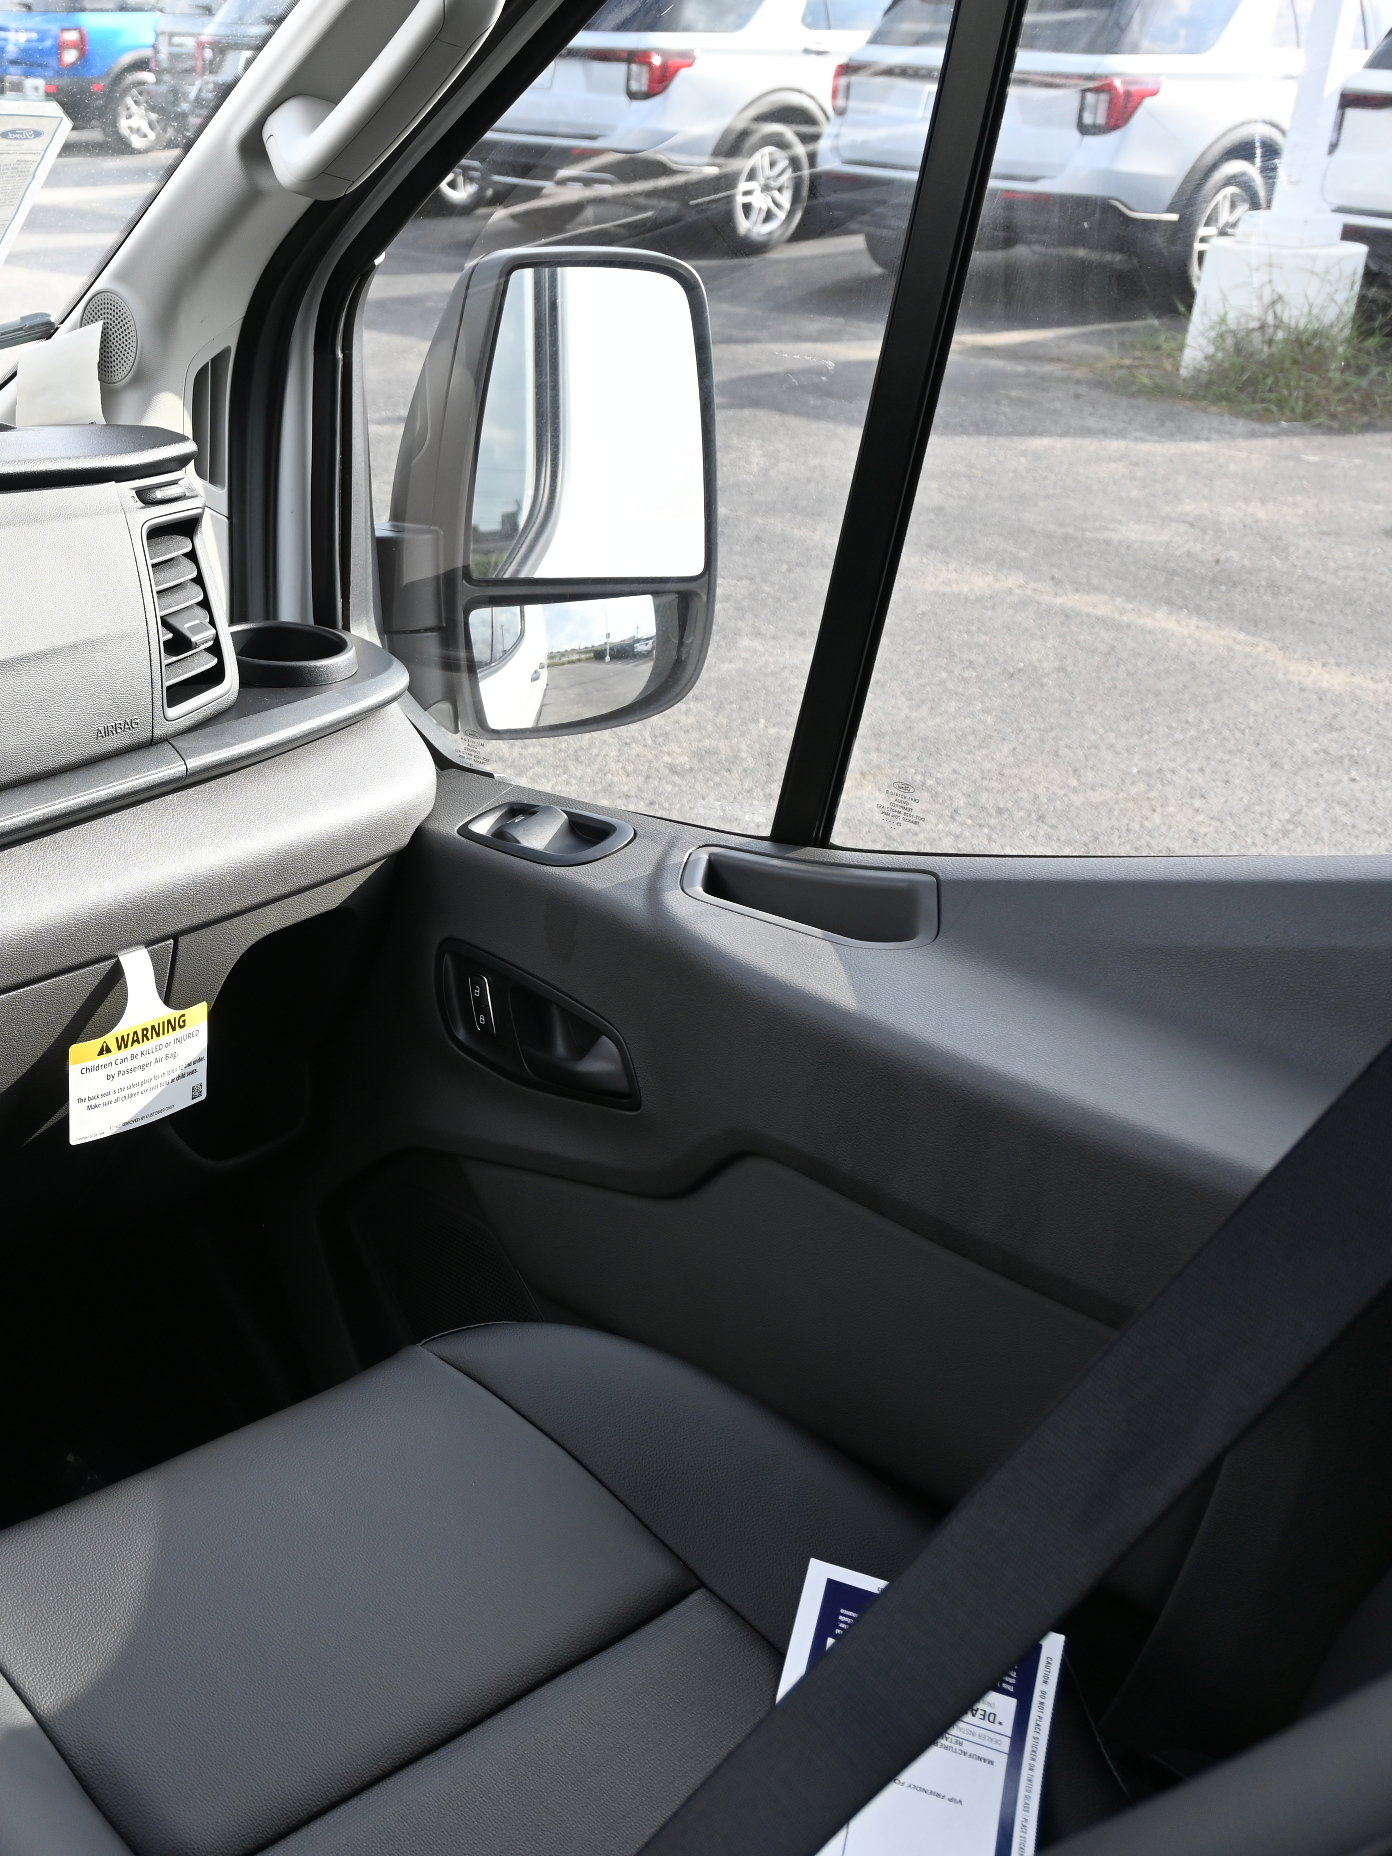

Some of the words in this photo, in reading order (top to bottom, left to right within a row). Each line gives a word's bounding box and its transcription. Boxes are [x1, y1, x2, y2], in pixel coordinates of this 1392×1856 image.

[96, 716, 138, 740] AIRBAG
[115, 1013, 187, 1051] WARNING
[80, 1062, 113, 1076] Children
[114, 1057, 128, 1066] Can
[130, 1053, 138, 1062] Be
[140, 1044, 164, 1059] KILLED
[164, 1042, 172, 1050] or
[173, 1029, 200, 1046] INJURED
[106, 1073, 116, 1082] by
[117, 1061, 153, 1078] Passenger
[154, 1058, 164, 1067] Air
[77, 1096, 87, 1104] The
[88, 1093, 100, 1102] back
[100, 1090, 112, 1099] seat
[86, 1102, 102, 1111] Make
[1042, 1656, 1053, 1686] CAUTION
[978, 1734, 1002, 1746] DEALER
[906, 1784, 946, 1800] FRIENDLY
